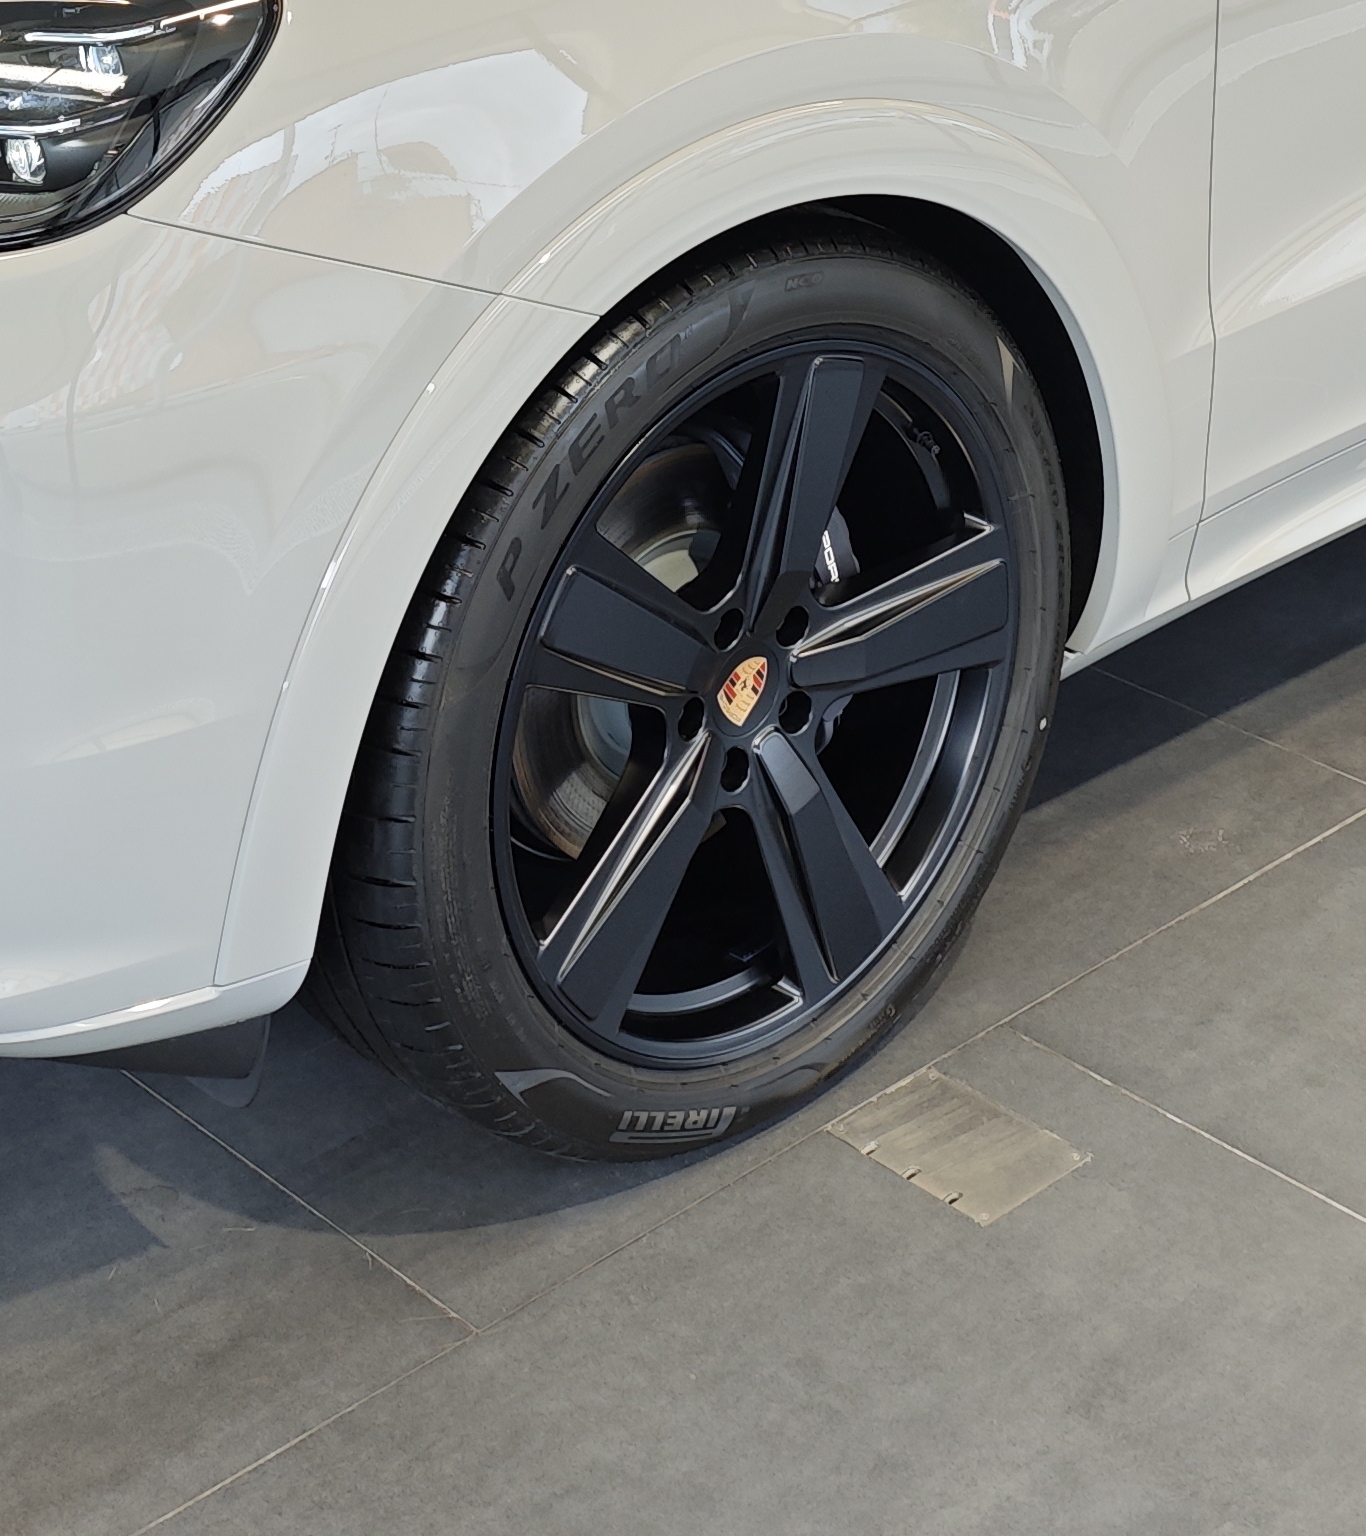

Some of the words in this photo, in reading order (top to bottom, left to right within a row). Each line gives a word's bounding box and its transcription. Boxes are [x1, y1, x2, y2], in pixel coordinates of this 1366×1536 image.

[496, 536, 523, 602] P
[532, 332, 682, 530] ZERO
[609, 1106, 737, 1144] PIRELLI
